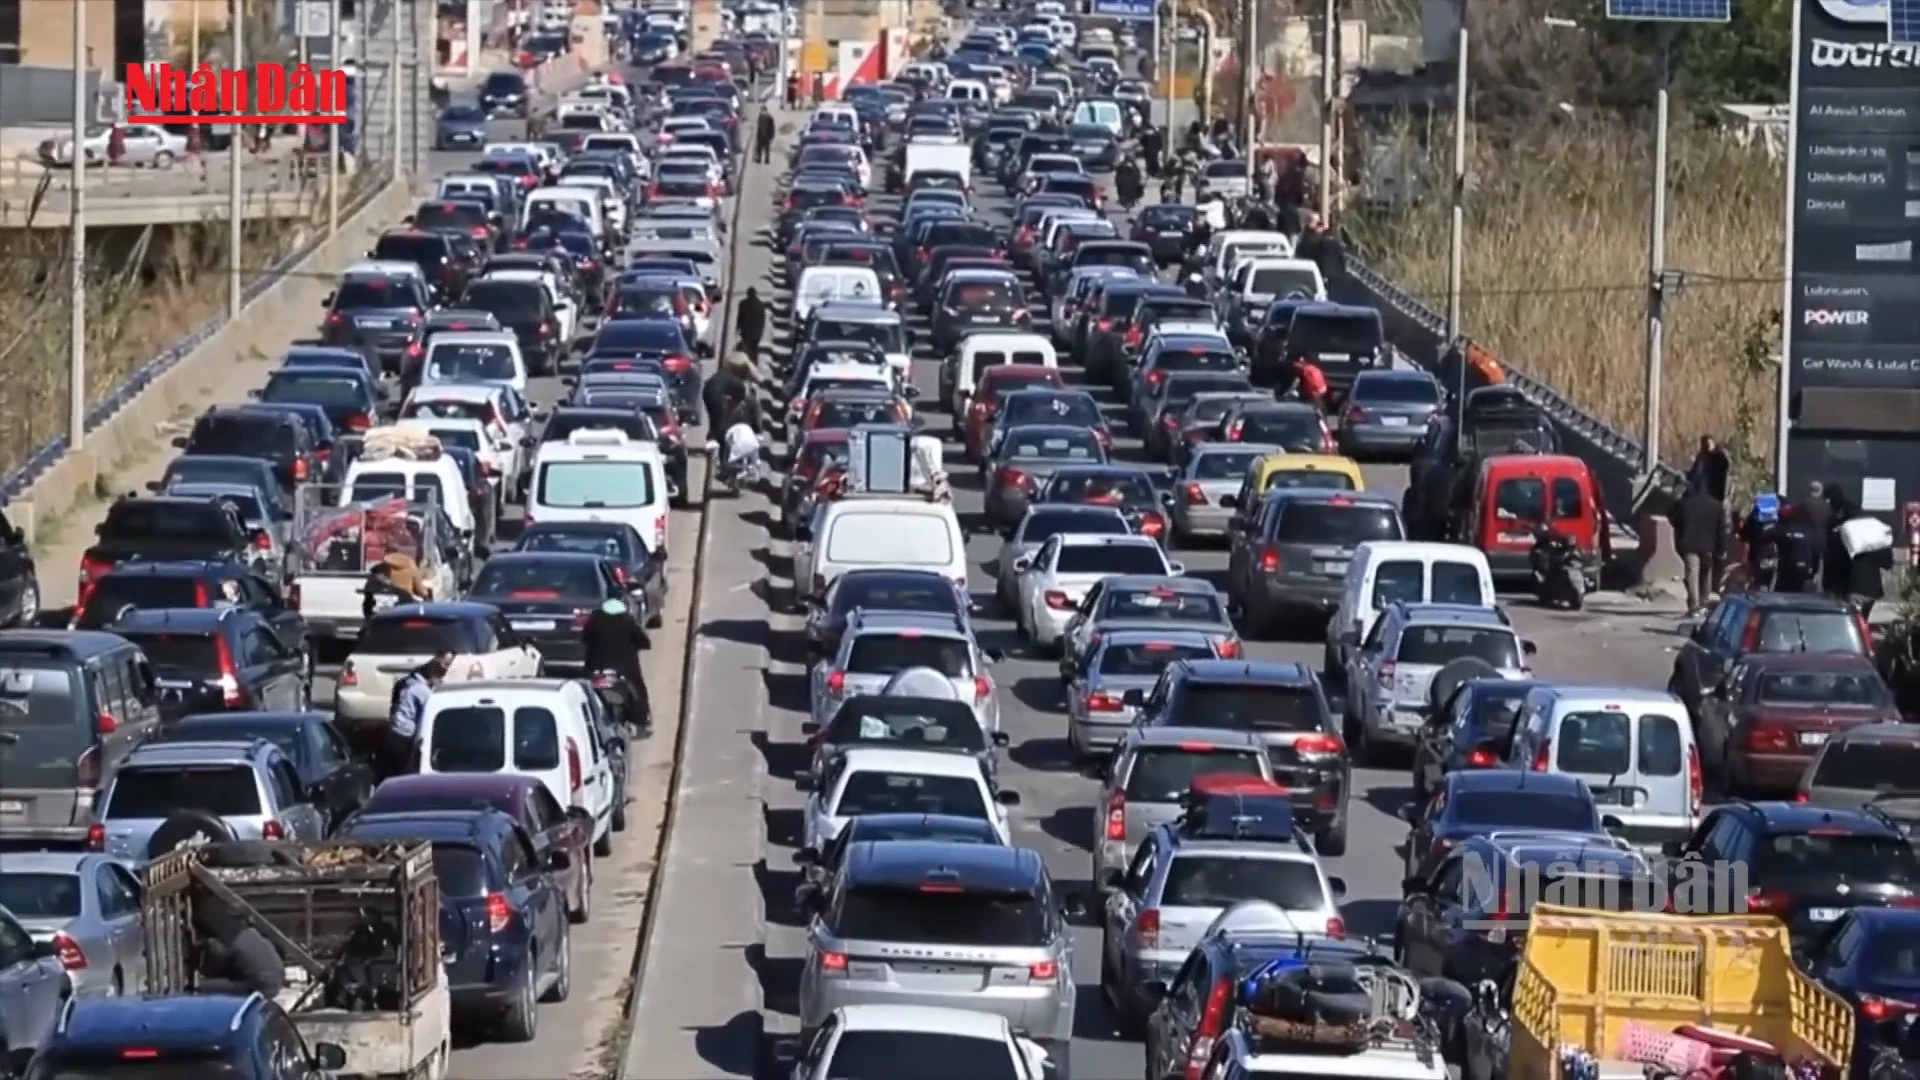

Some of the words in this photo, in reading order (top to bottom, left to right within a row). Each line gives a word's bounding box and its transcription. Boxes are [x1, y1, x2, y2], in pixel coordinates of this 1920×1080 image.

[1804, 309, 1868, 325] POWER
[1802, 358, 1824, 369] Car
[1826, 358, 1861, 369] Wash
